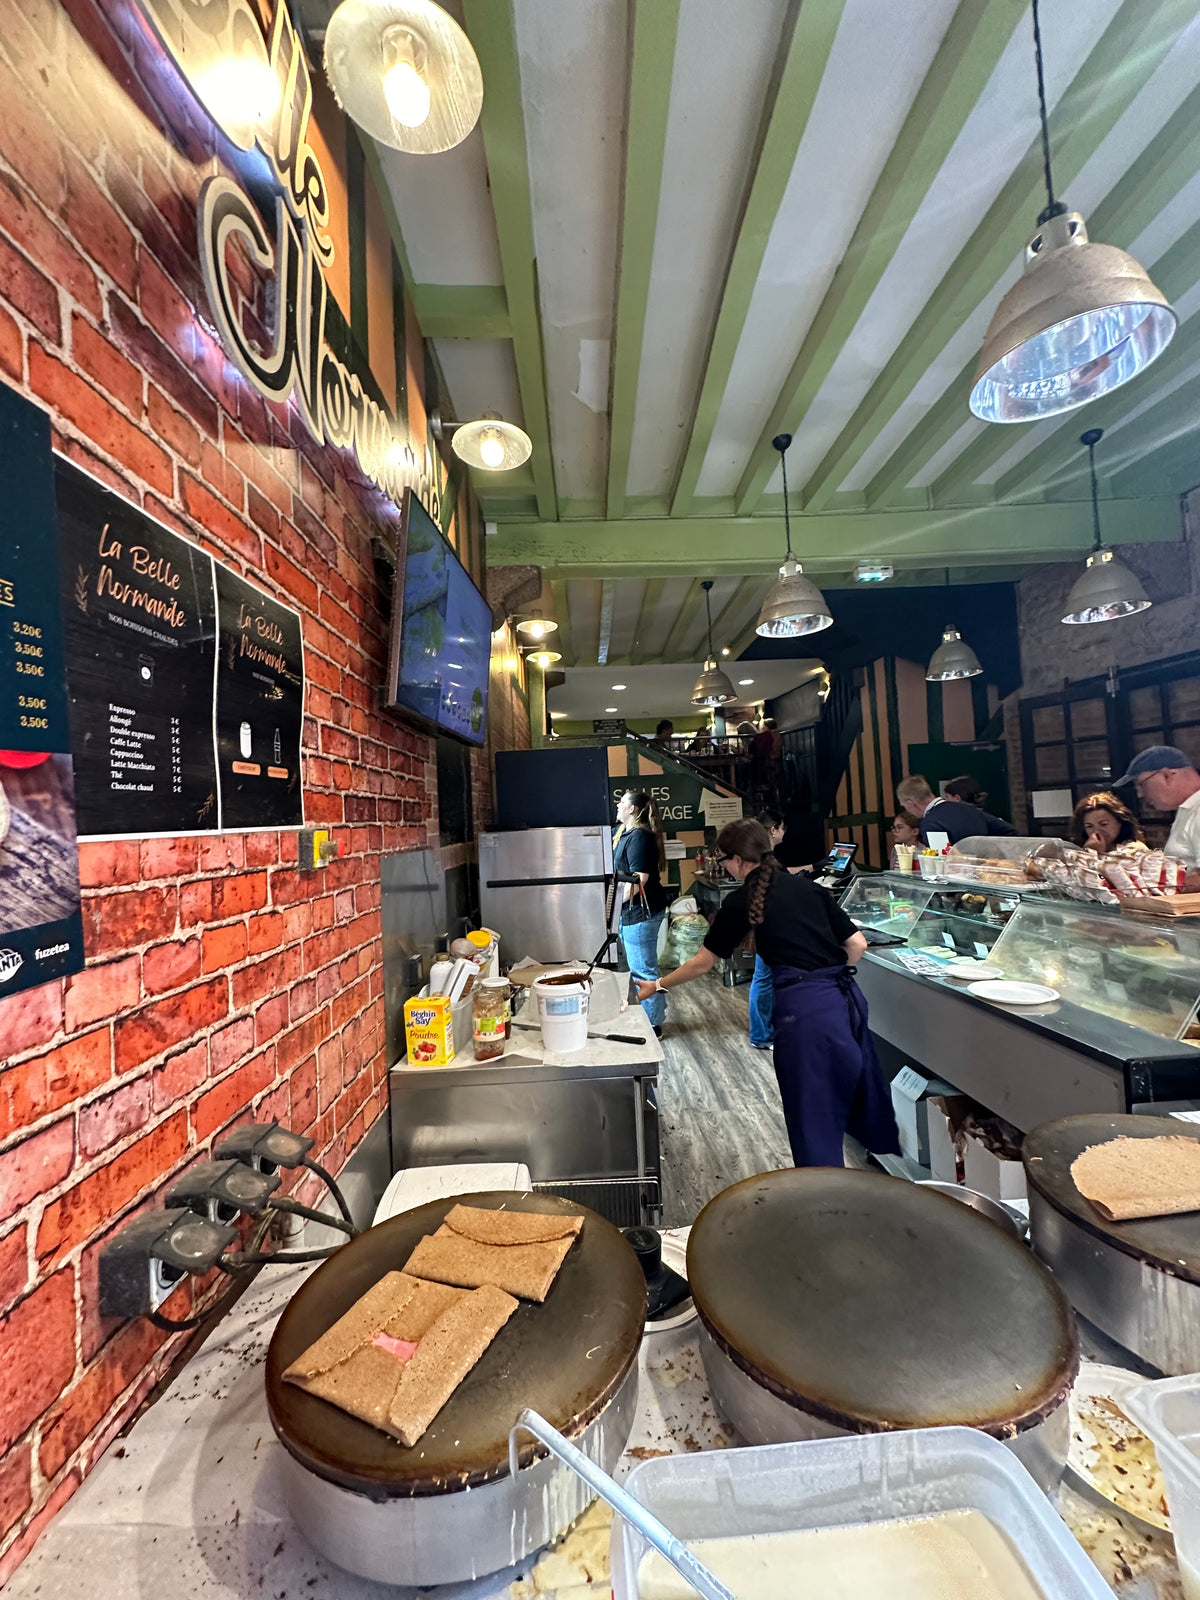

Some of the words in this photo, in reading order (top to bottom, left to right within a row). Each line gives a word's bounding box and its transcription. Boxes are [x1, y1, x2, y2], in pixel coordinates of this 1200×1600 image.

[98, 523, 122, 560] La
[129, 545, 181, 590] Belle
[97, 564, 186, 628] Normande
[237, 603, 252, 629] La
[254, 616, 283, 646] Belle
[239, 633, 287, 674] Normande
[109, 726, 131, 736] Double
[126, 740, 142, 749] Latte
[110, 748, 144, 759] Cappuccino
[110, 759, 126, 768] Latte
[127, 761, 155, 771] Macchiato
[110, 770, 123, 779] Thé
[110, 781, 136, 791] Chocolat
[137, 782, 154, 791] chaud
[613, 787, 670, 804] SES
[34, 943, 70, 960] fuzetea
[410, 1010, 436, 1019] Béghin
[415, 1017, 431, 1027] Say
[409, 1030, 439, 1039] Poudre
